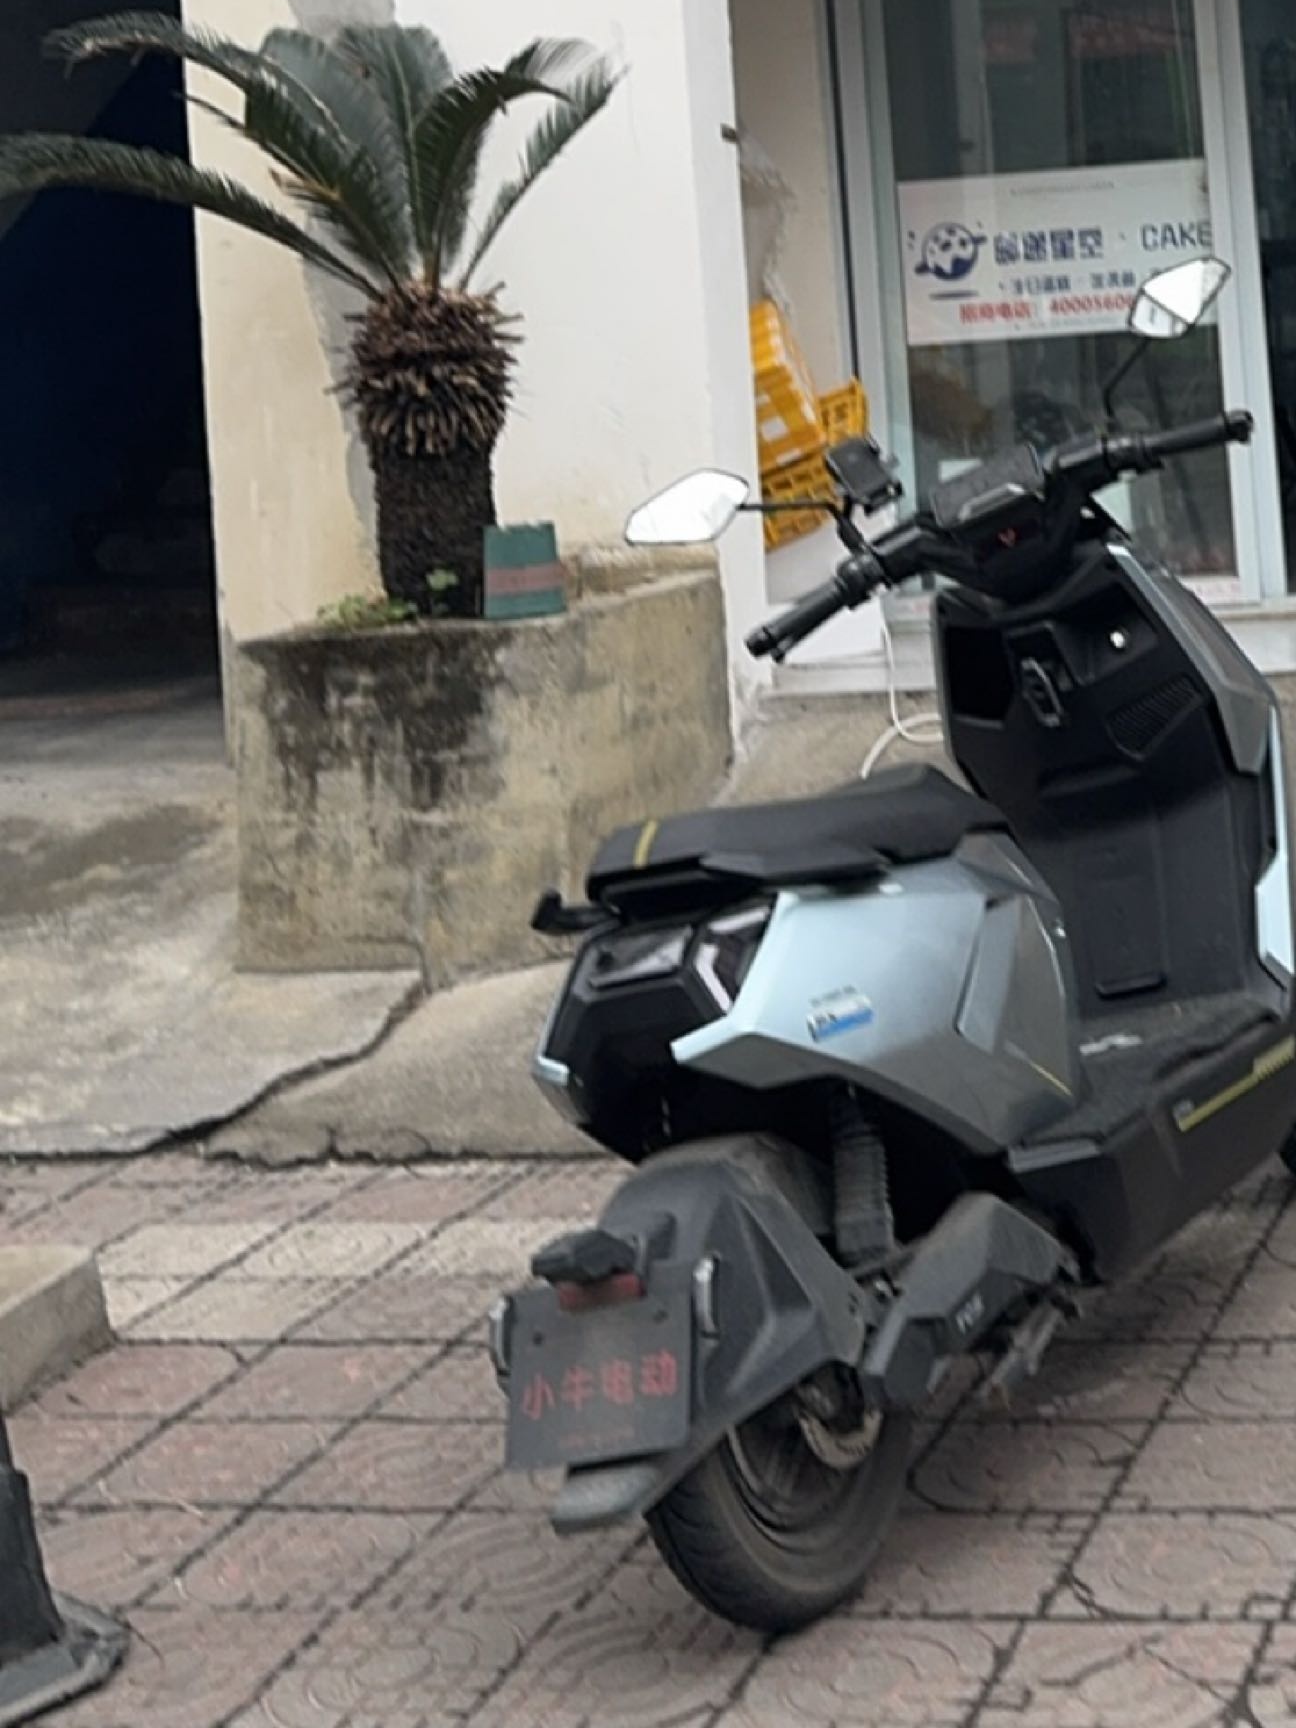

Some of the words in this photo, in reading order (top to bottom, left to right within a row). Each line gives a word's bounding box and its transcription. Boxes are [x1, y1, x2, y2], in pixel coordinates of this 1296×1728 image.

[1140, 221, 1213, 252] CAKE
[520, 1347, 679, 1421] 小牛电动
